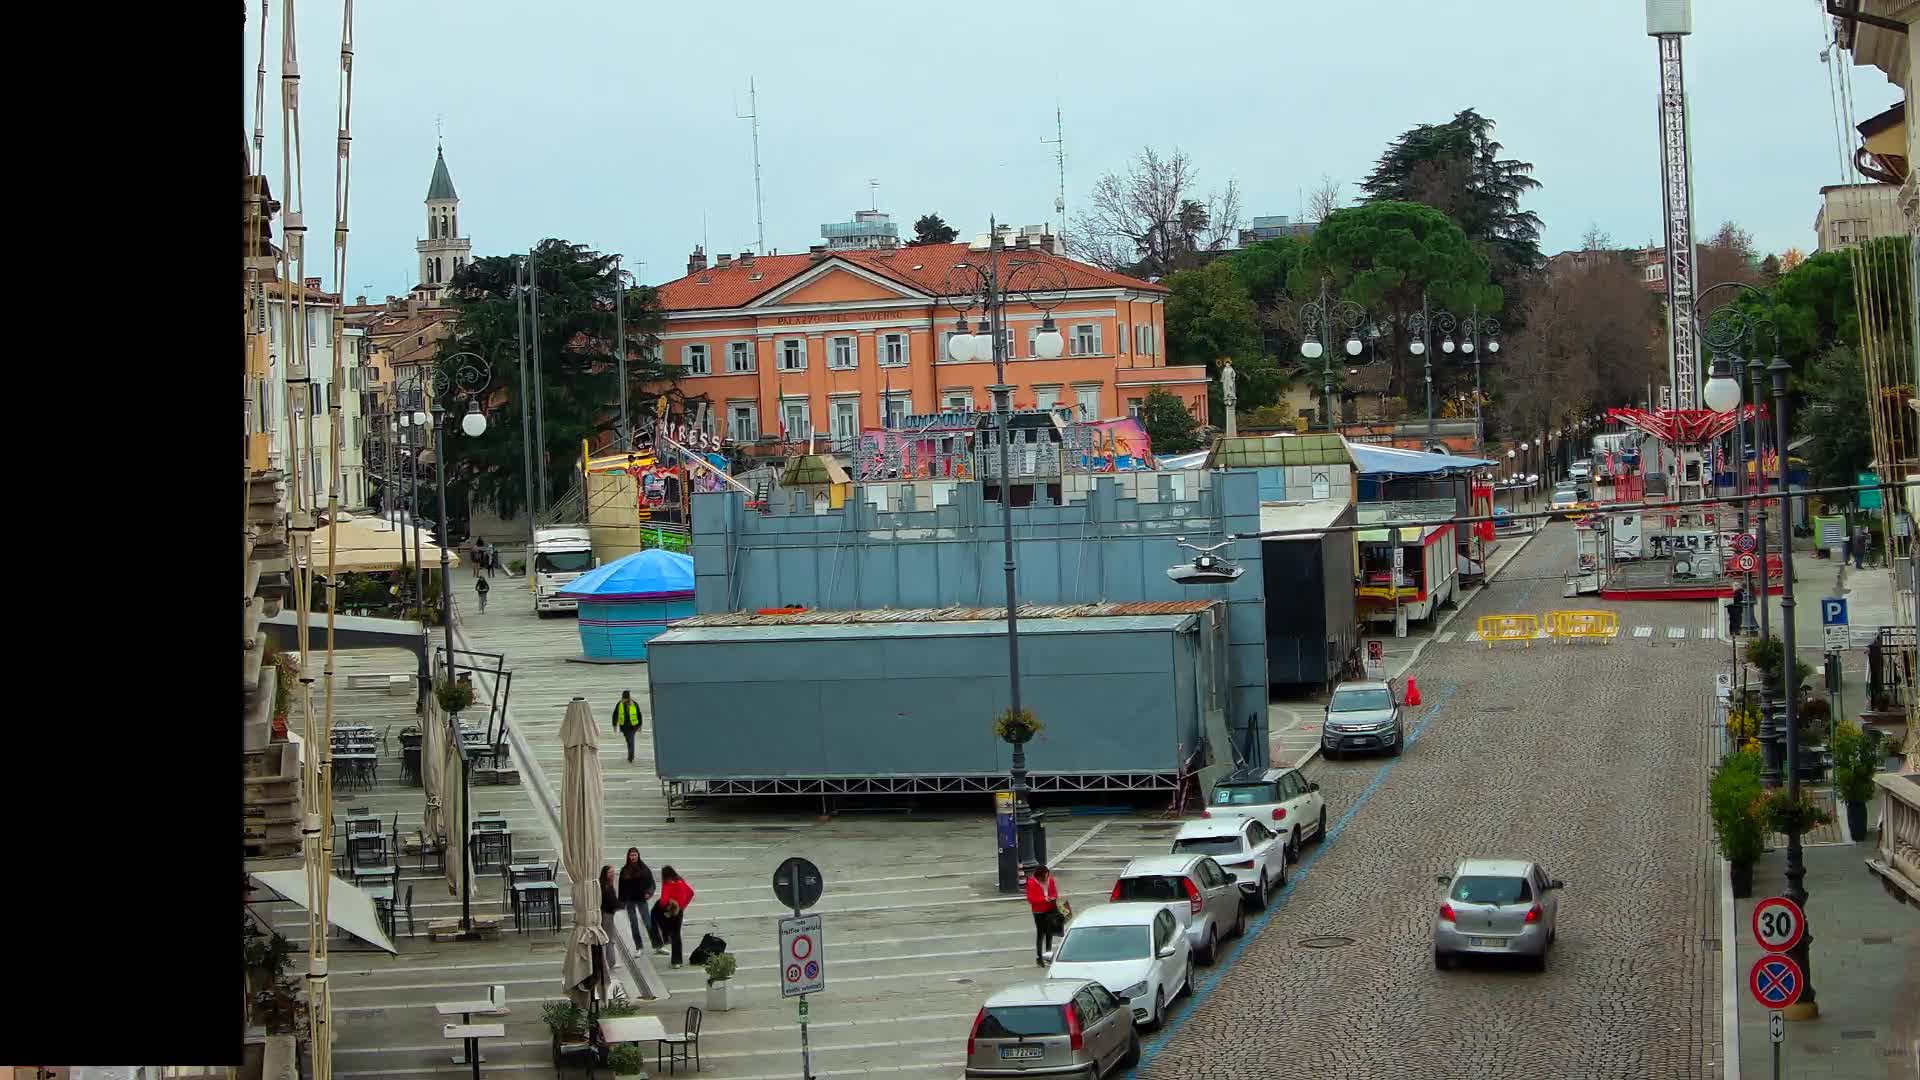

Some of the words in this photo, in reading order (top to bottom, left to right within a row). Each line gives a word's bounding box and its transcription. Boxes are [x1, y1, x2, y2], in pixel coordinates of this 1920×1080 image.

[1741, 558, 1752, 567] 20
[1827, 602, 1841, 622] P
[1762, 911, 1791, 938] 30
